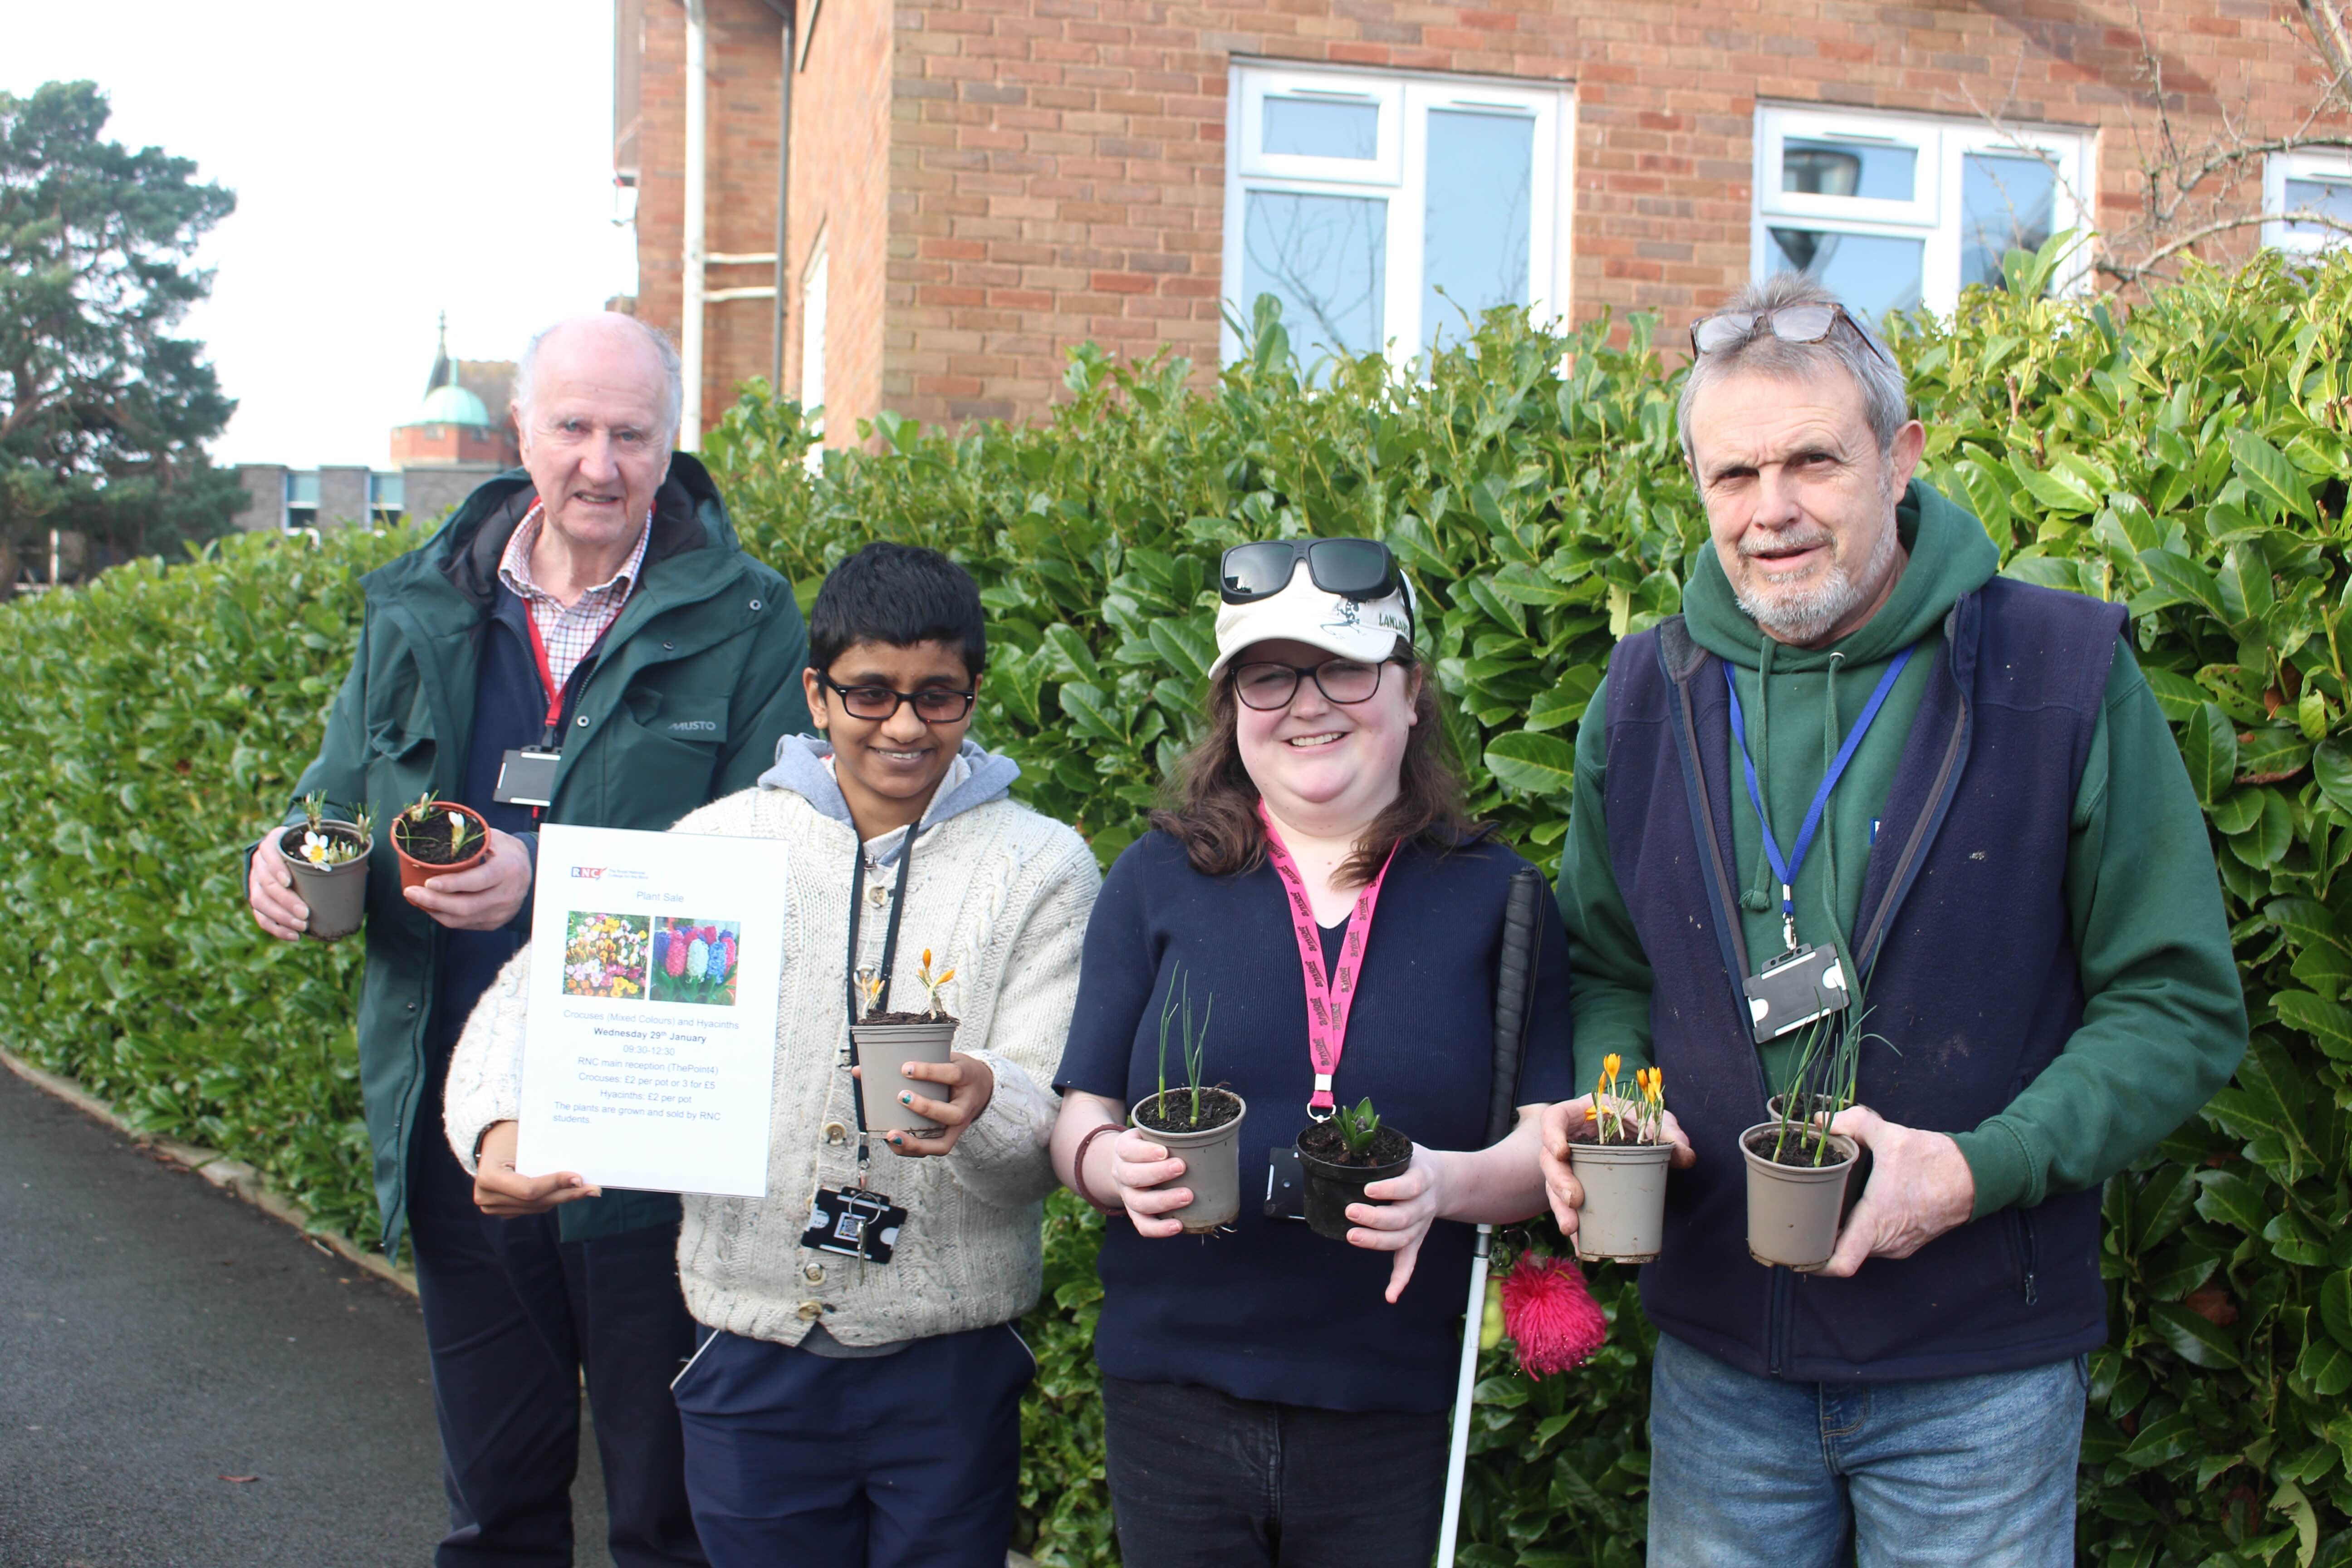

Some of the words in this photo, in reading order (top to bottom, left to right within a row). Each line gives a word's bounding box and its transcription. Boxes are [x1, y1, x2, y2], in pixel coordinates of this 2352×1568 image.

[668, 721, 716, 731] MUSTO
[572, 867, 599, 878] RNC
[637, 891, 660, 901] Plant
[664, 893, 684, 902] Sale
[564, 1009, 603, 1020] Crocuses
[607, 1013, 636, 1023] (Mixed
[639, 1015, 675, 1026] Colours)
[678, 1018, 694, 1026] and
[697, 1019, 739, 1029] Hyacinths
[594, 1028, 647, 1039] Wednesday
[669, 1033, 706, 1044] January
[623, 1045, 675, 1055] 09:30-12:30
[578, 1057, 598, 1067] RNC
[601, 1059, 622, 1068] main
[625, 1061, 665, 1072] reception
[667, 1063, 718, 1075] (ThePoint4)
[578, 1073, 621, 1083] Crocuses:
[638, 1078, 652, 1087] per
[655, 1079, 668, 1087] pot
[704, 1081, 715, 1089] £5
[600, 1089, 645, 1101] Hyacinths:
[647, 1093, 658, 1101] £2
[661, 1095, 676, 1103] per
[678, 1095, 691, 1104] pot
[554, 1101, 570, 1110] The
[573, 1103, 598, 1114] plants
[618, 1106, 645, 1117] grown
[647, 1108, 663, 1117] and
[666, 1110, 684, 1118] sold
[686, 1111, 697, 1120] by
[699, 1111, 721, 1120] RNC
[553, 1114, 591, 1124] students.
